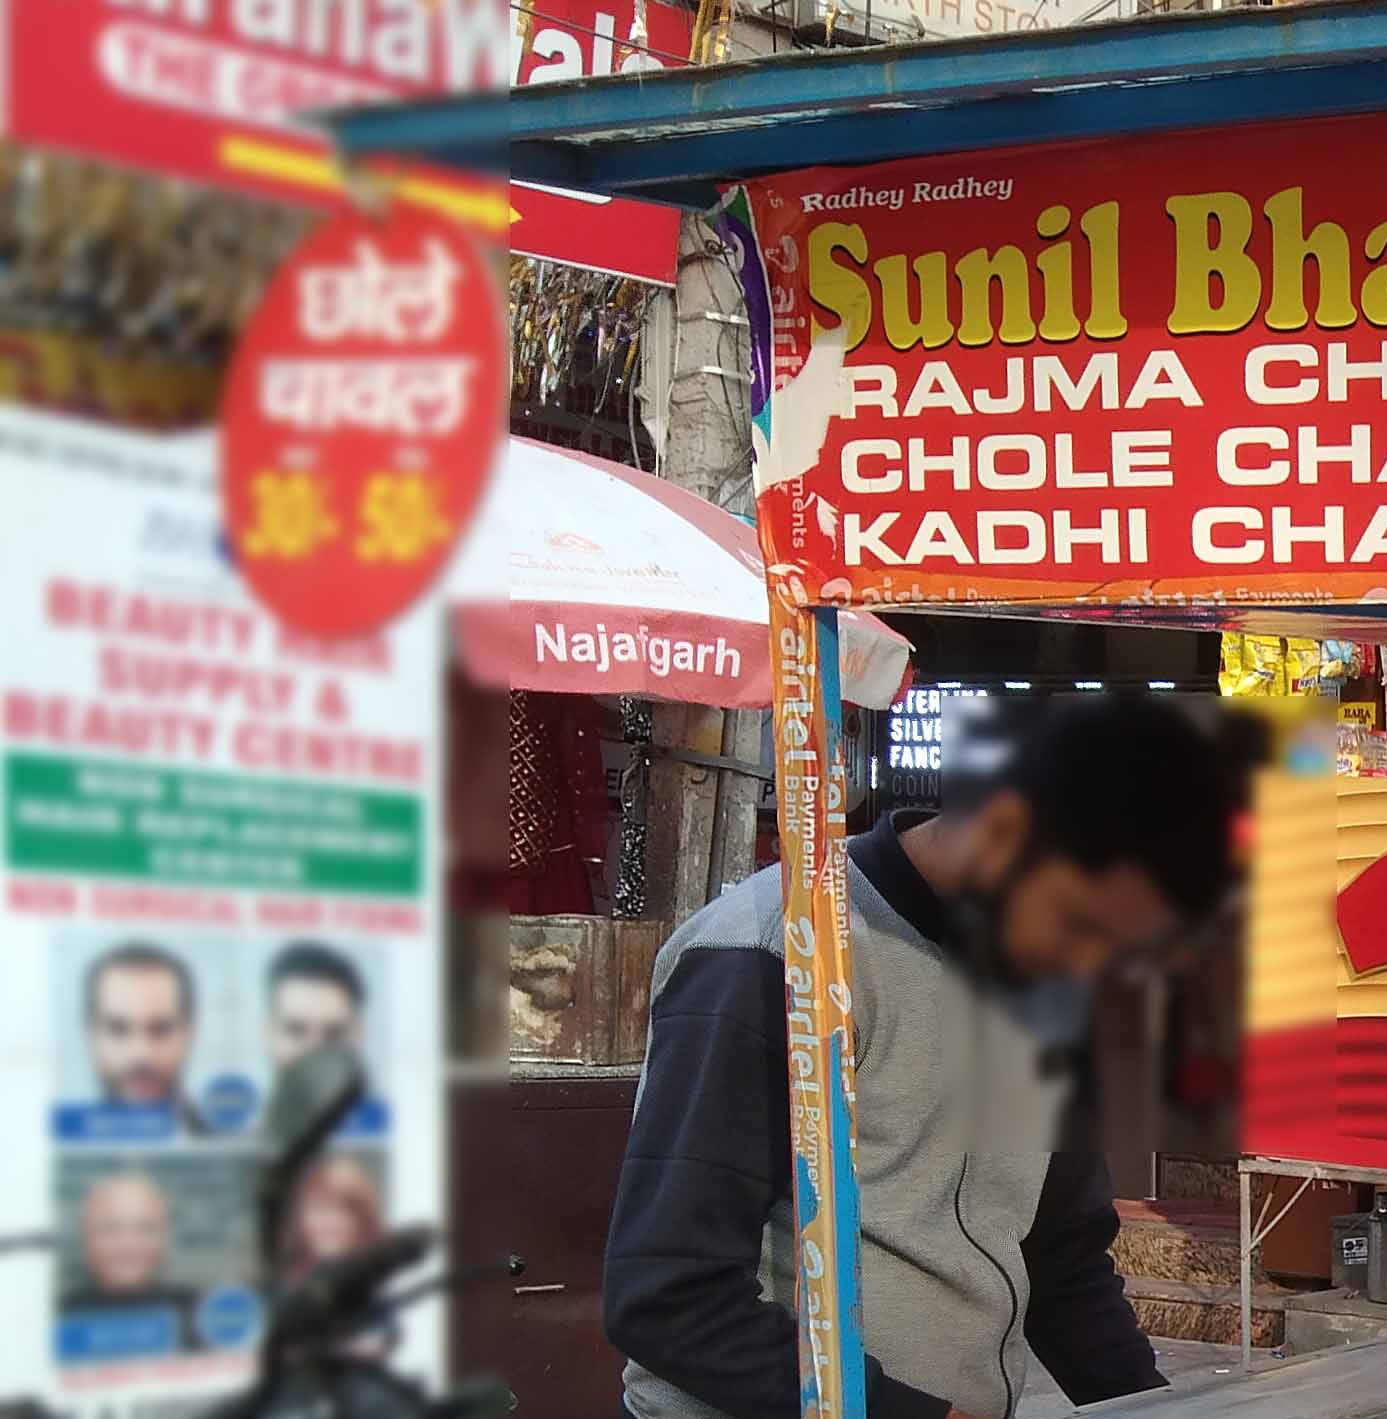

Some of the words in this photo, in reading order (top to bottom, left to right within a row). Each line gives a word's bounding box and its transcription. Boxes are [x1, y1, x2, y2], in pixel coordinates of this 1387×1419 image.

[803, 181, 905, 213] Radhey
[912, 174, 1014, 204] Radhey
[809, 204, 1128, 352] Sunil
[841, 350, 1204, 419] RAJMA
[841, 429, 1174, 493] CHOLE
[844, 508, 1148, 566] KADHI
[534, 623, 741, 678] Najafgarh
[779, 627, 819, 763] airtel
[784, 775, 799, 833] Bank
[801, 776, 819, 890] Payments
[784, 962, 820, 1098] airtel
